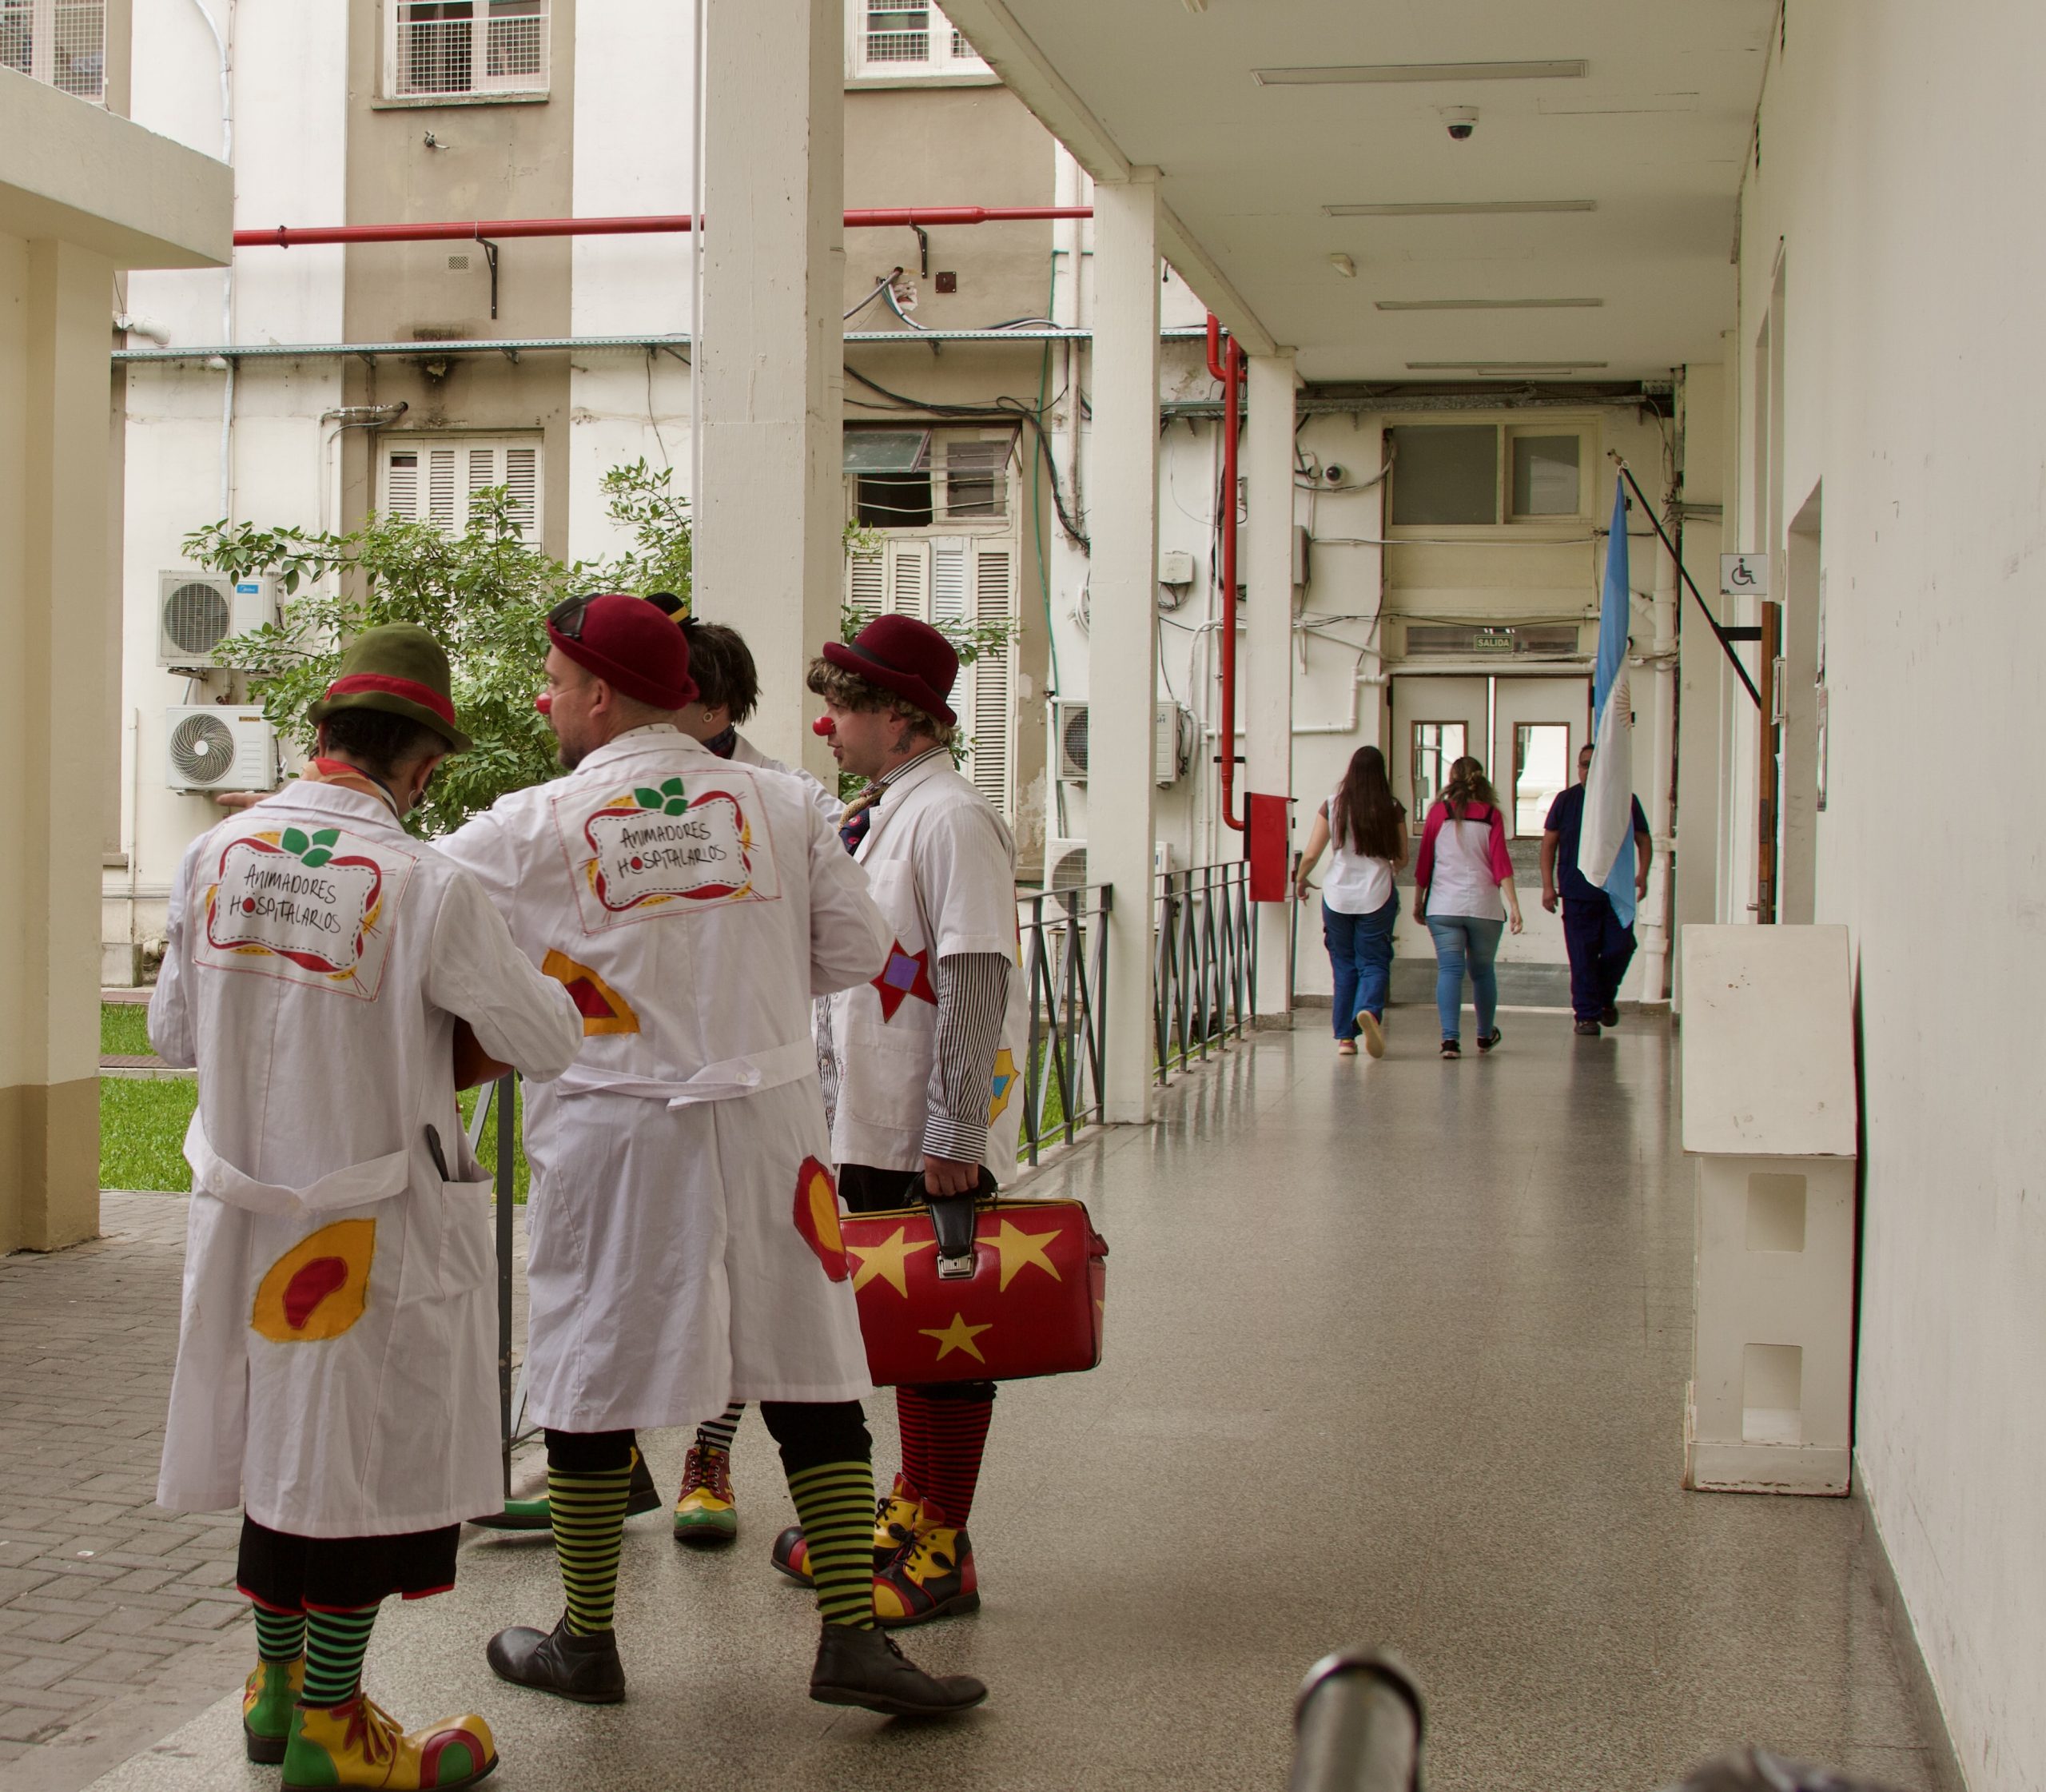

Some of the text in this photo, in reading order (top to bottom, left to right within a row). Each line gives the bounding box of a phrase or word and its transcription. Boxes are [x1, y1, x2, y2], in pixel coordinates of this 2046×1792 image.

[1478, 639, 1510, 647] SALIDA
[621, 822, 711, 848] ANIMADORES
[245, 864, 336, 903] ANIMADORES
